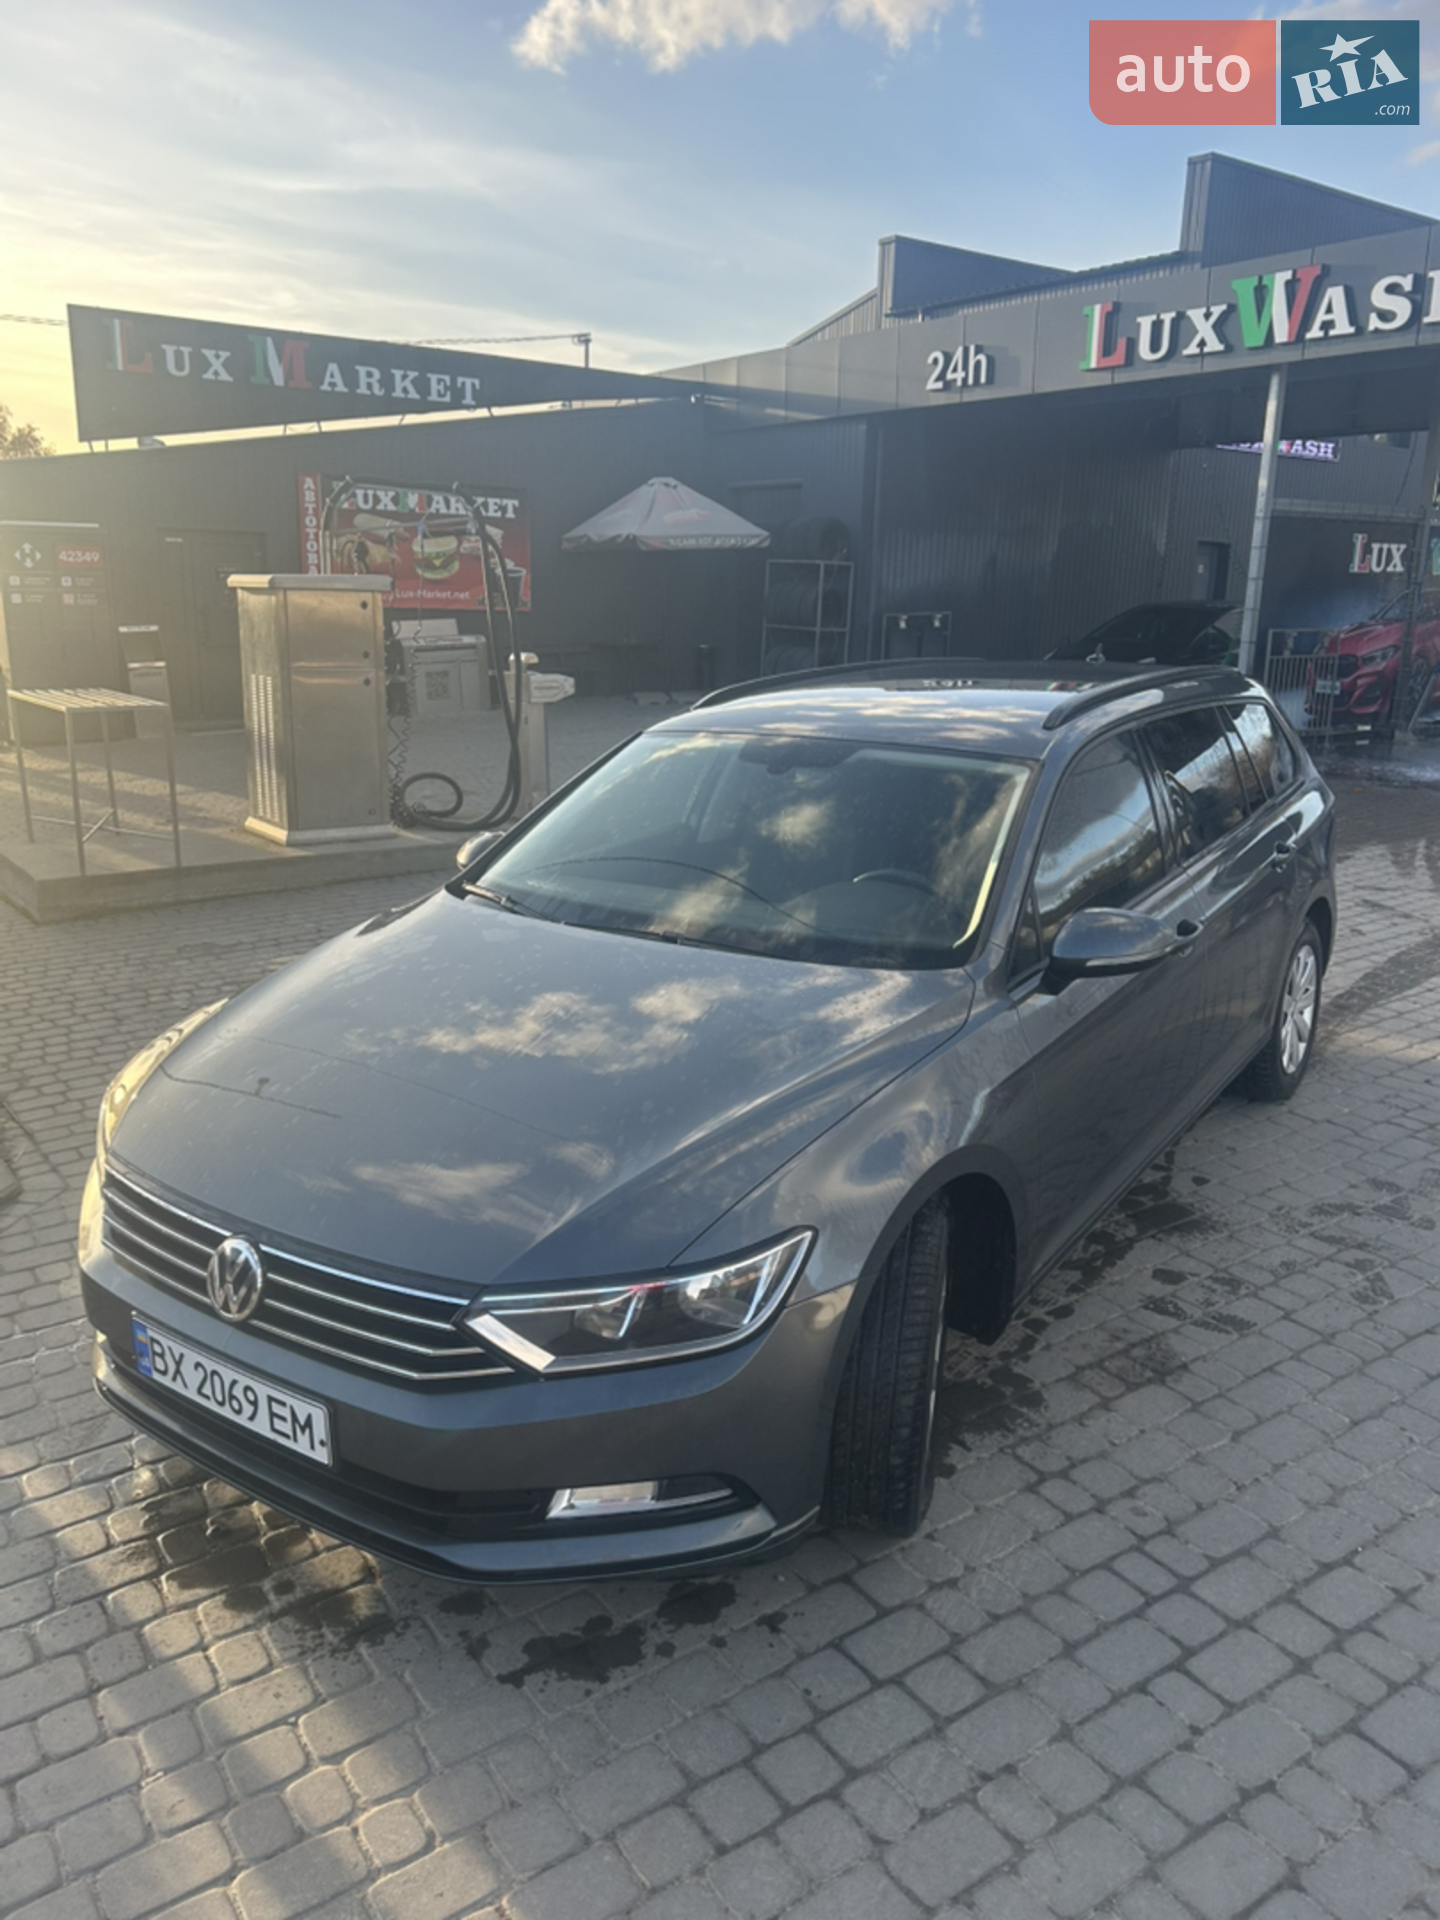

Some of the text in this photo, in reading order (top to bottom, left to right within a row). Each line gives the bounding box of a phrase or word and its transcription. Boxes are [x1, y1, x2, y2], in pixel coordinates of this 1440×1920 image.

[925, 343, 990, 391] 24h
[58, 550, 100, 562] 42349
[193, 1361, 259, 1422] 2069
[266, 1394, 316, 1452] EM
